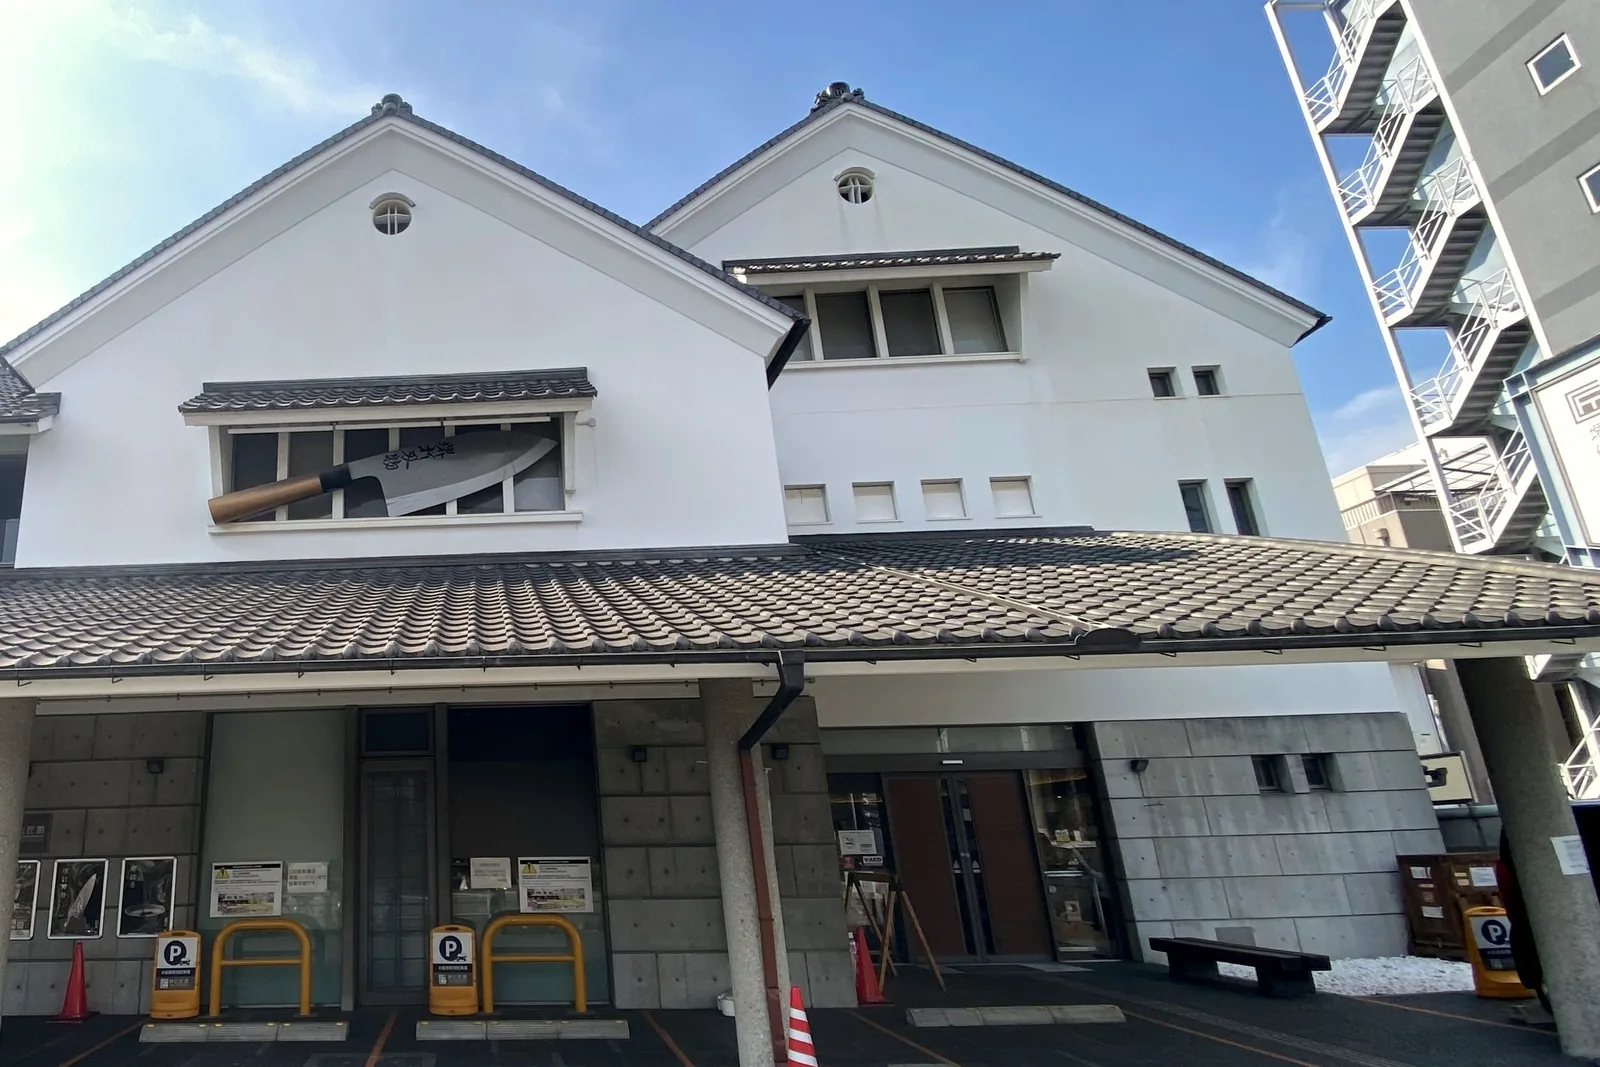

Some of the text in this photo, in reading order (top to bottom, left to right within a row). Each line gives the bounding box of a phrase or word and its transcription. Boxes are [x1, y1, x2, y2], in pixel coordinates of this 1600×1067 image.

[1487, 925, 1503, 941] P
[169, 946, 182, 962] P
[445, 941, 457, 957] P
